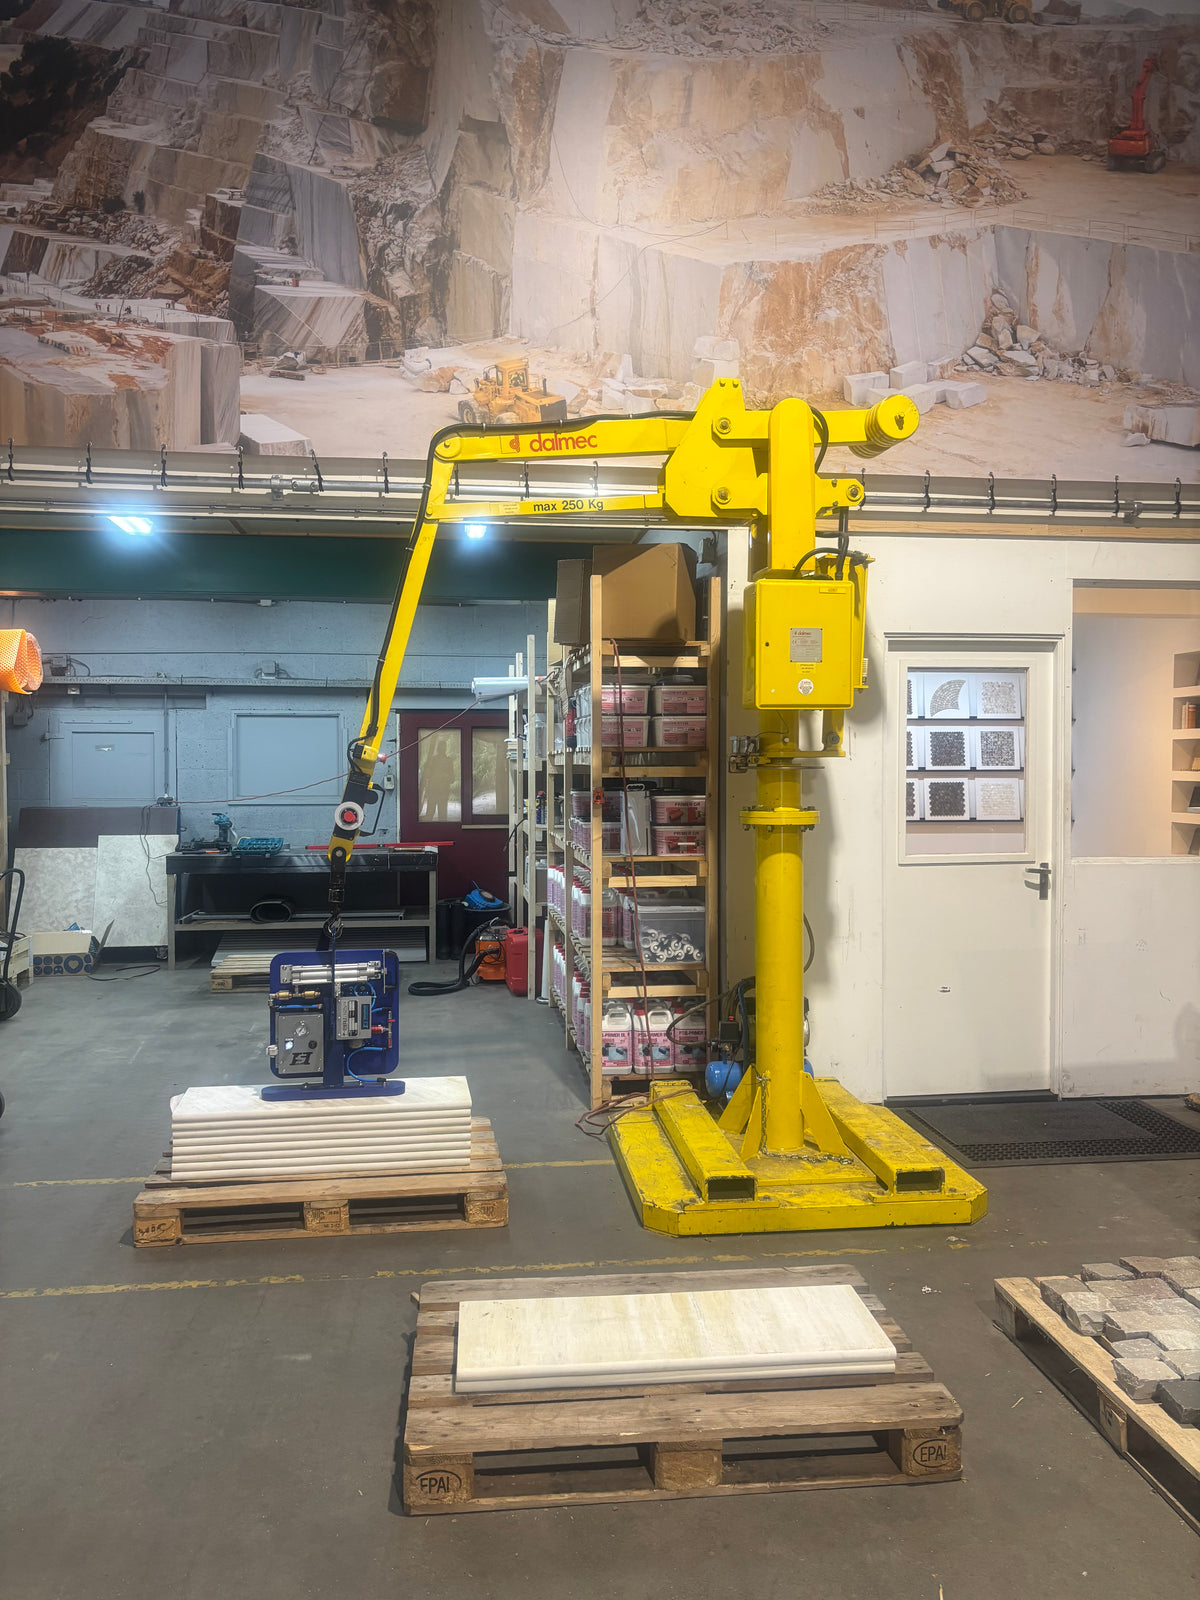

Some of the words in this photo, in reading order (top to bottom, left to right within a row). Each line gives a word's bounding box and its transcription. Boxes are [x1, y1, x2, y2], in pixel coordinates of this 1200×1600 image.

[529, 430, 598, 452] dalmec
[533, 502, 557, 512] max
[561, 499, 584, 511] 250
[588, 499, 604, 511] Kg
